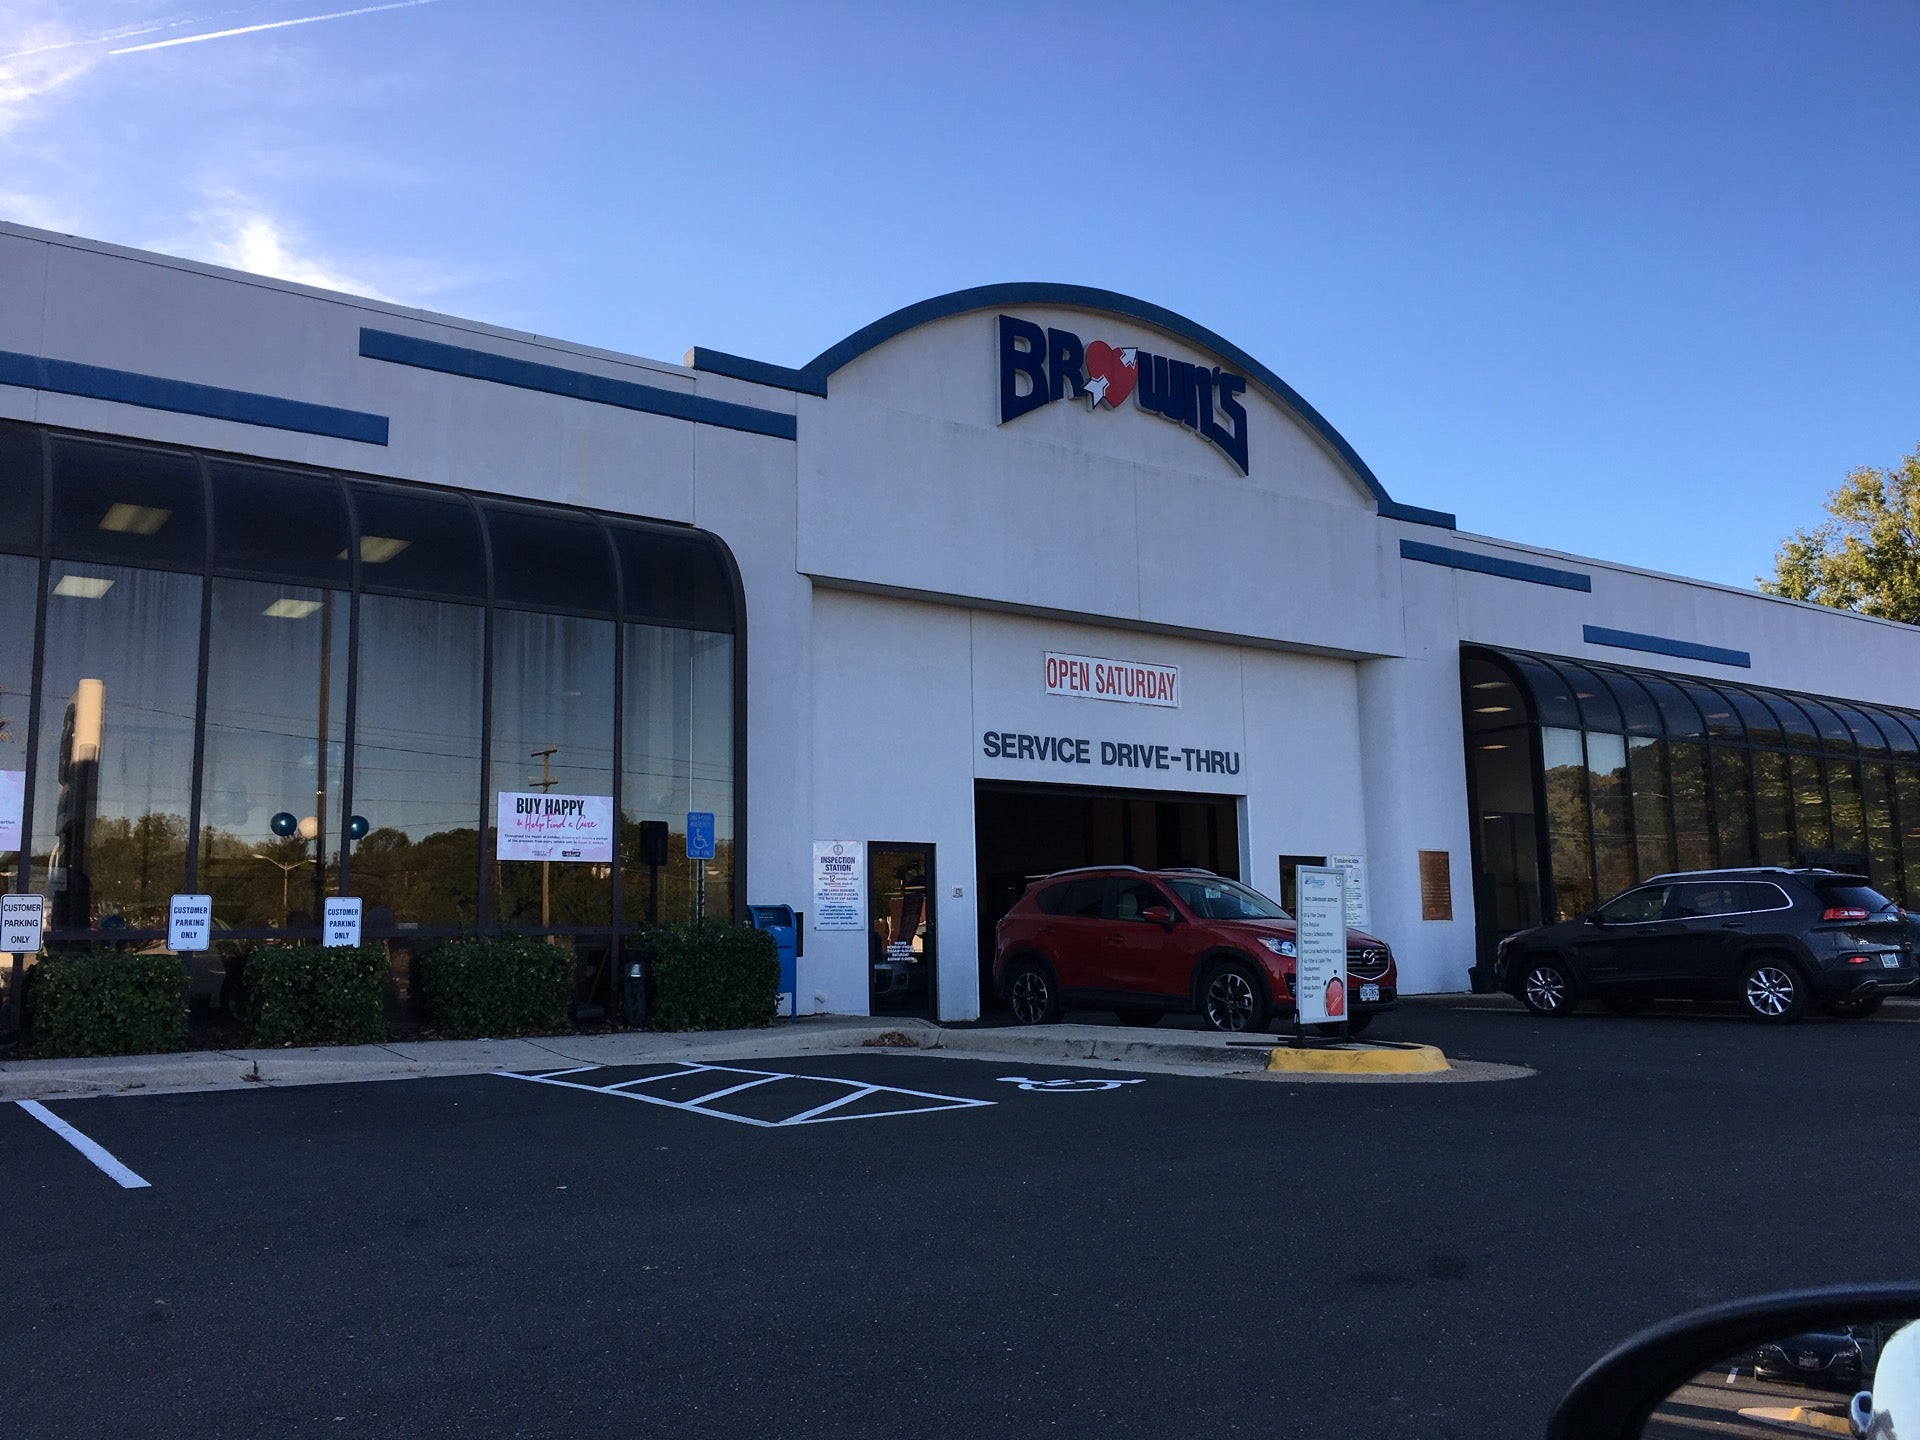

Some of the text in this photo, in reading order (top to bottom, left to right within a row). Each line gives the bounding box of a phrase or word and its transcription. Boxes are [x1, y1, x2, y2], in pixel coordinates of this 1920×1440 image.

[1046, 657, 1177, 702] OPEN SATURDAY
[983, 731, 1240, 775] SERVICE DRIVE-THRU
[516, 797, 585, 816] BUY HAPPY
[525, 813, 544, 832] Help
[543, 812, 566, 829] Find
[575, 814, 598, 831] Cure
[820, 856, 856, 864] INSPECTION
[825, 864, 852, 872] STATION
[829, 875, 836, 883] 12
[3, 903, 41, 912] CUSTOMER
[173, 906, 208, 914] CUSTOMER
[327, 908, 359, 916] CUSTOMER
[4, 919, 39, 928] PARKING
[175, 919, 205, 927] PARKING
[329, 920, 356, 928] PARKING
[180, 931, 198, 939] ONLY
[334, 932, 350, 940] ONLY
[10, 935, 31, 944] ONLY
